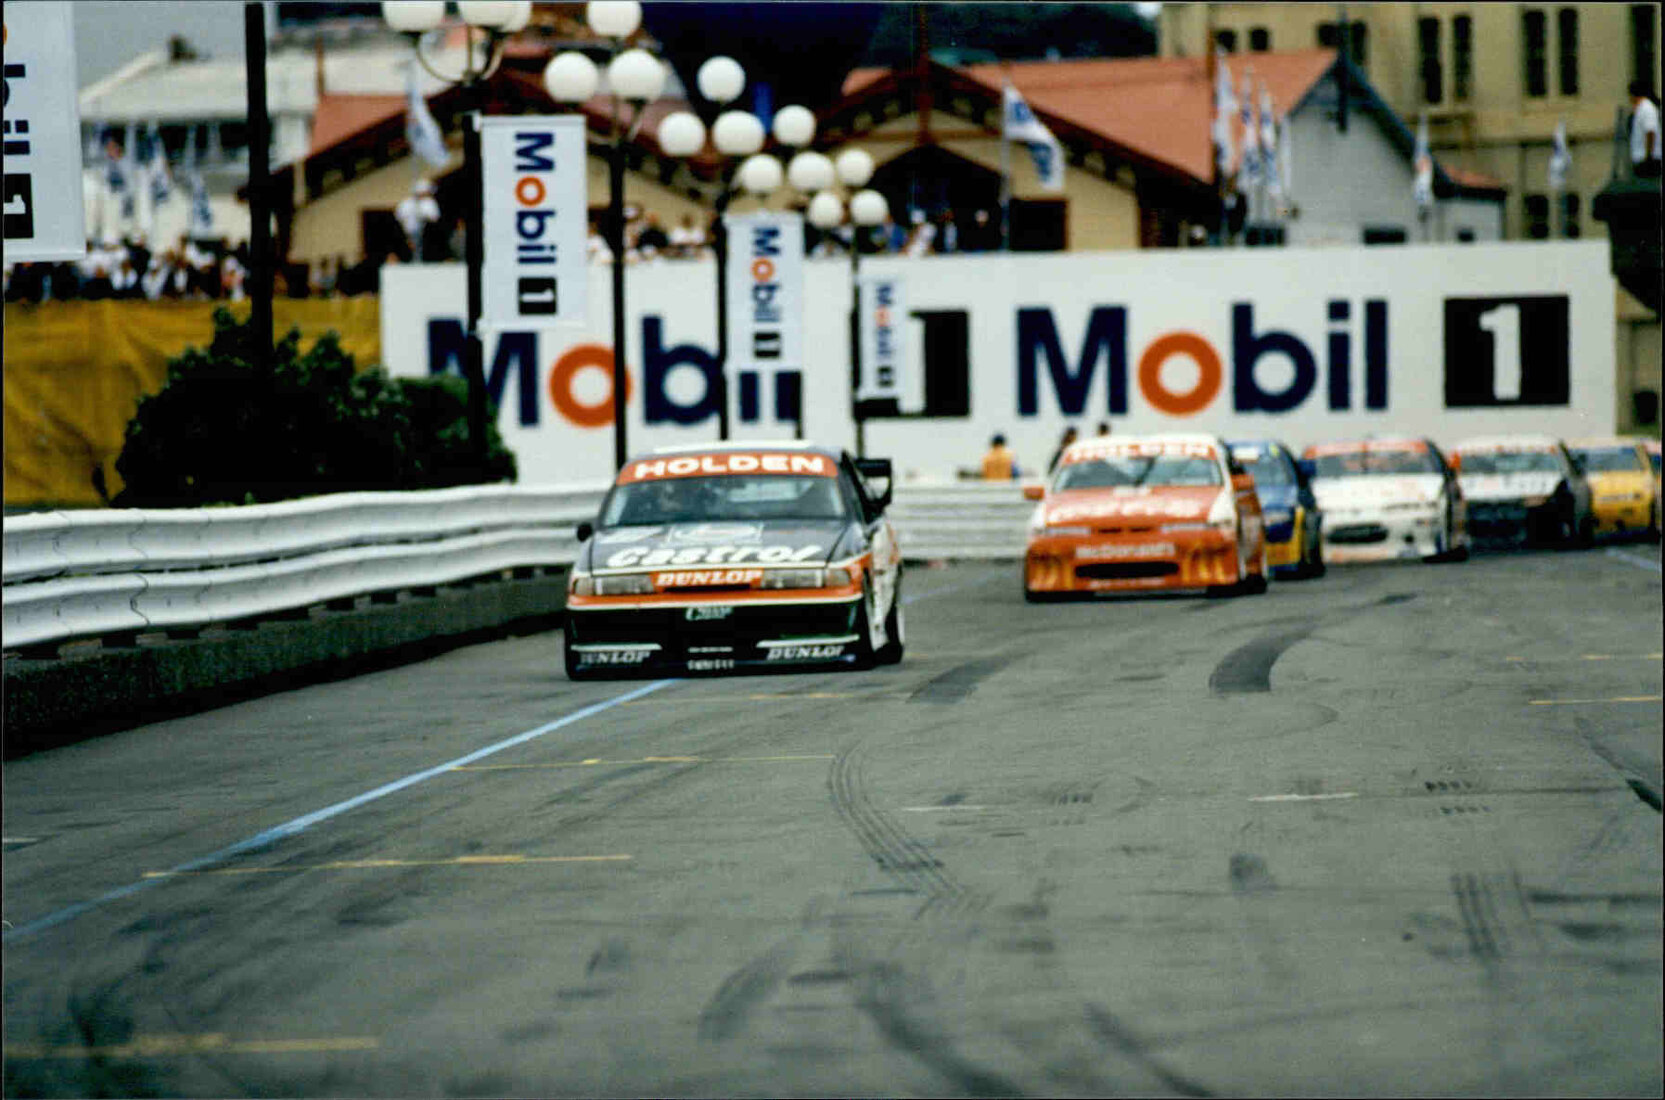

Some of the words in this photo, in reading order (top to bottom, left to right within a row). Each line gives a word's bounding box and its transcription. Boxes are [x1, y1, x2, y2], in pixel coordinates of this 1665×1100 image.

[515, 132, 556, 264] Mobil
[752, 227, 781, 322] Mobil
[1015, 300, 1389, 416] Mobil
[633, 454, 825, 480] HOLDEN
[606, 544, 824, 568] Castrol
[656, 569, 763, 586] DUNLOP
[767, 646, 845, 661] DUNLOP
